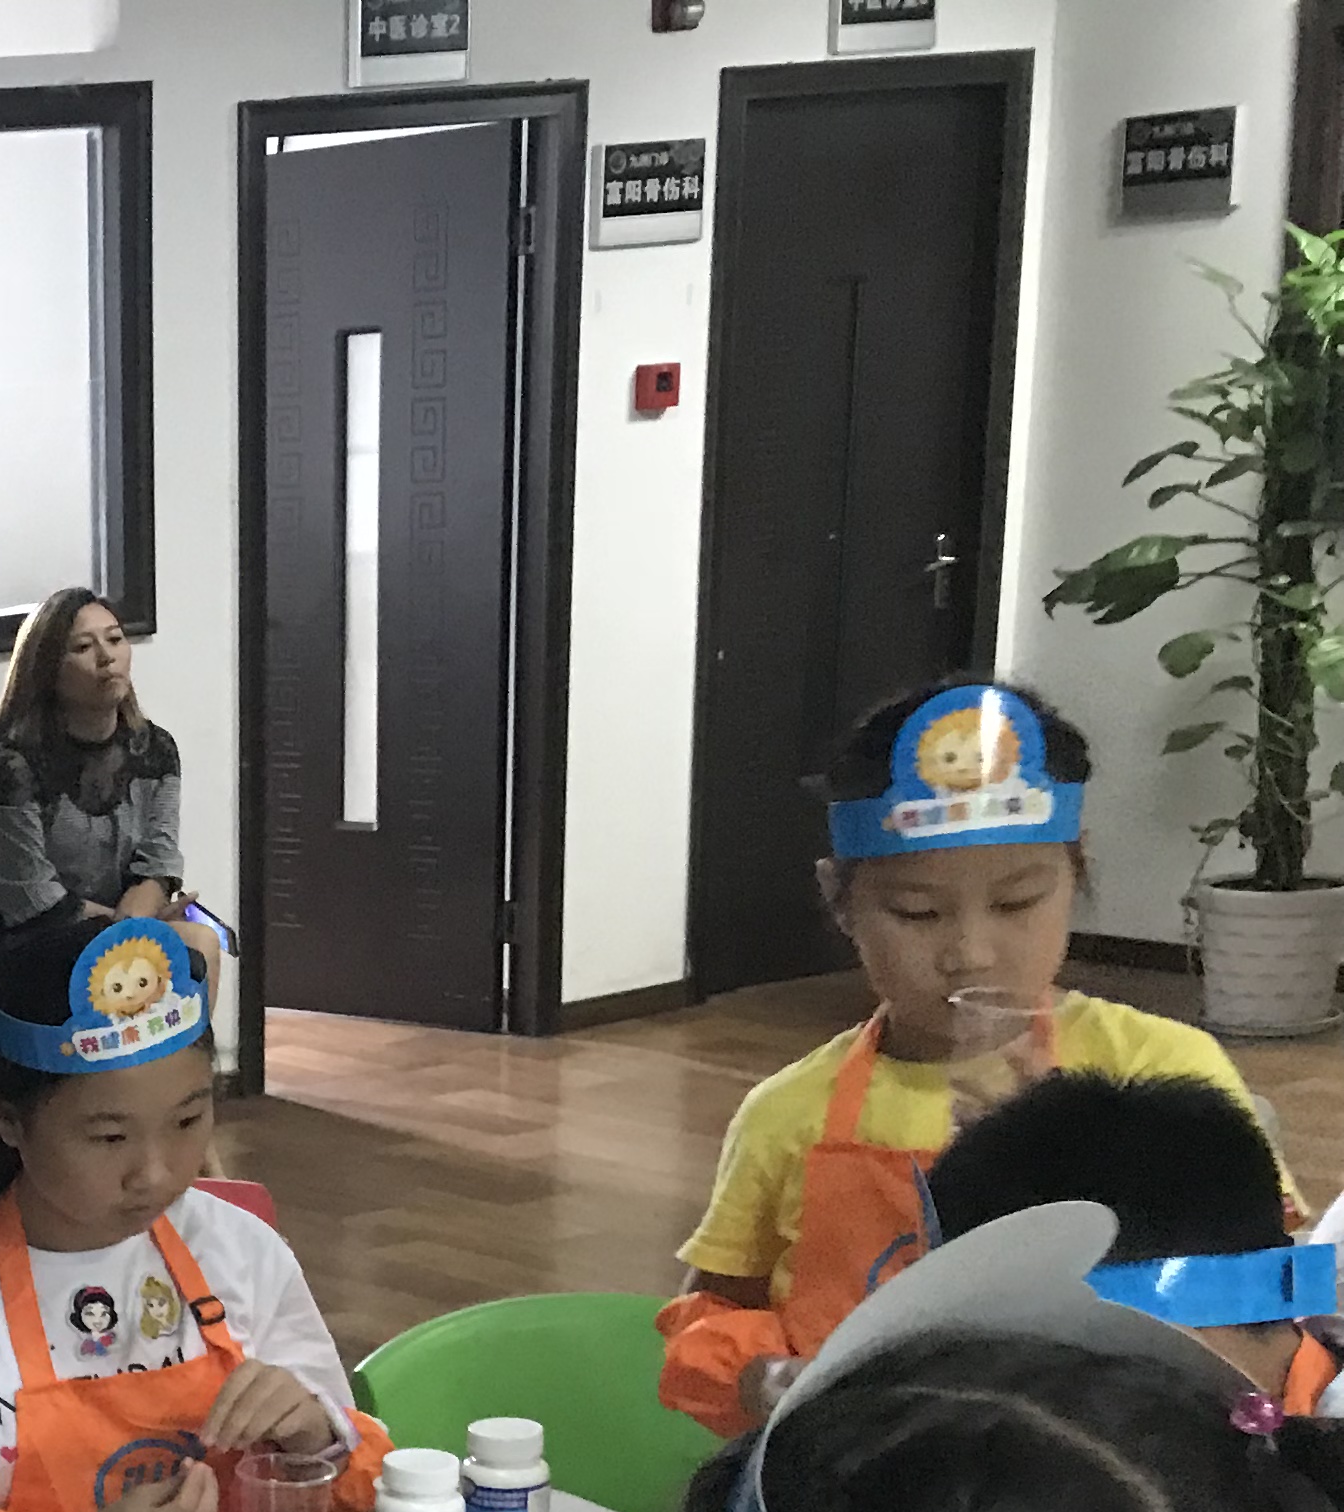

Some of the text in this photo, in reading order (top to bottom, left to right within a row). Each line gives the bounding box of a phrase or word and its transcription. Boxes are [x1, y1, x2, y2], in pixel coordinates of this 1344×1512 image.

[605, 174, 701, 206] 富阳骨伤科
